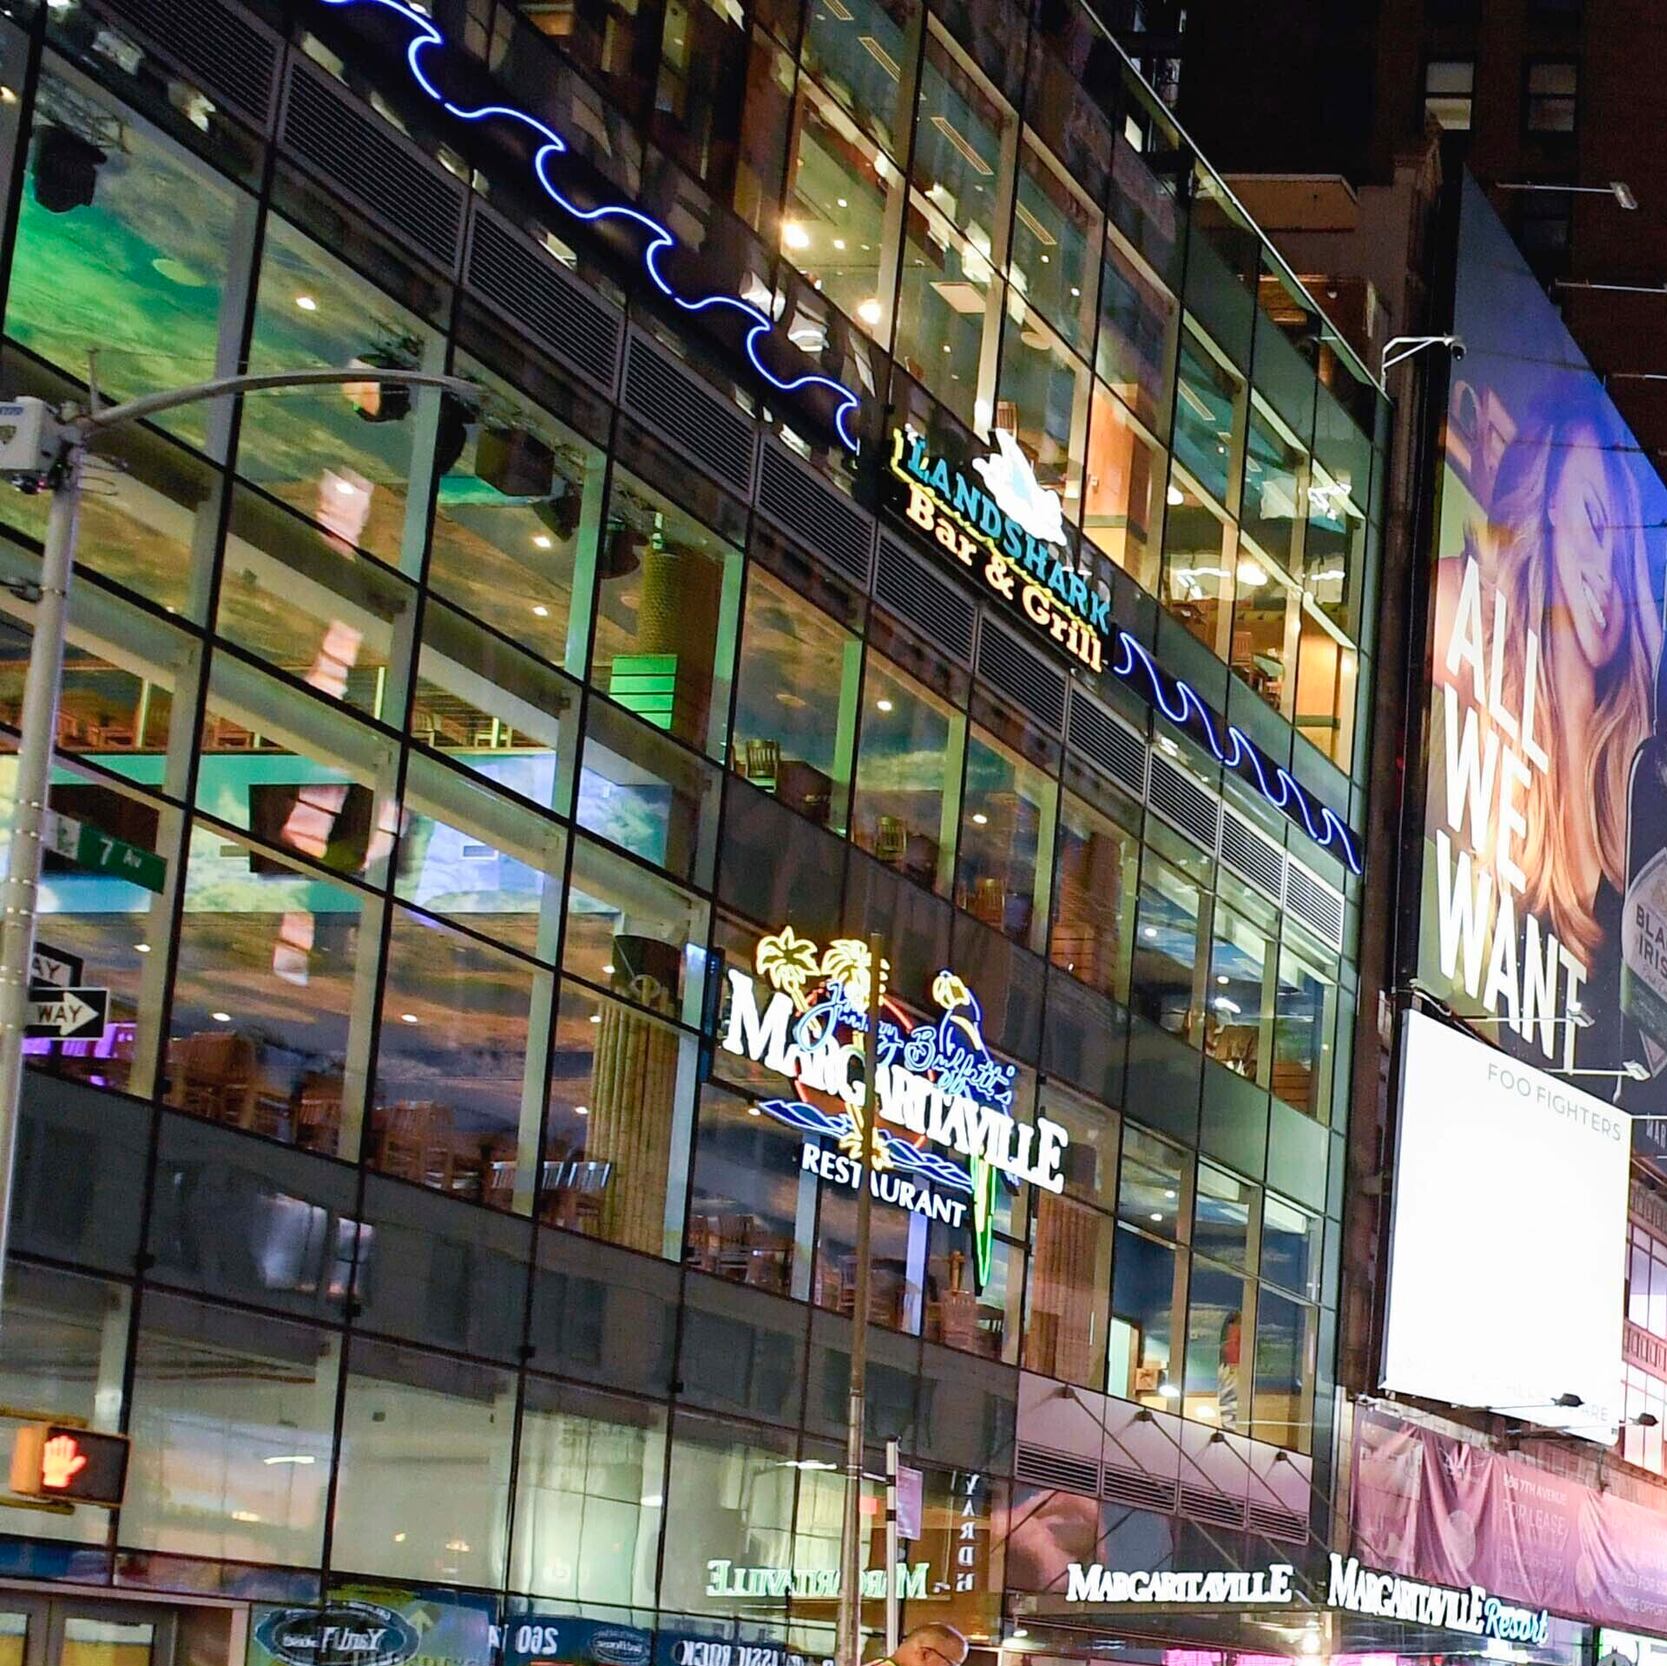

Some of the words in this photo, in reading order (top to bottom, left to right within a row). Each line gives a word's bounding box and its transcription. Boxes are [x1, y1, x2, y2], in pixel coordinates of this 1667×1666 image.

[906, 483, 977, 567] Bar
[985, 553, 1015, 600] &
[1022, 585, 1103, 673] Grill
[907, 436, 1111, 635] LANDSHARK
[1446, 555, 1549, 775] ALL
[100, 837, 113, 866] 7
[123, 849, 142, 868] Av
[1444, 682, 1531, 894] WE
[32, 957, 60, 979] AY
[37, 1004, 83, 1024] WAY
[1436, 829, 1587, 1077] WANT
[722, 968, 1069, 1196] MARGARITAVILLE
[1487, 1063, 1532, 1097] FOO
[1536, 1085, 1622, 1142] FIGHTERS
[1066, 1563, 1294, 1603] MARGARITAVILLE
[1328, 1553, 1485, 1633] MARGARITAVILLE
[1485, 1598, 1550, 1646] Resort
